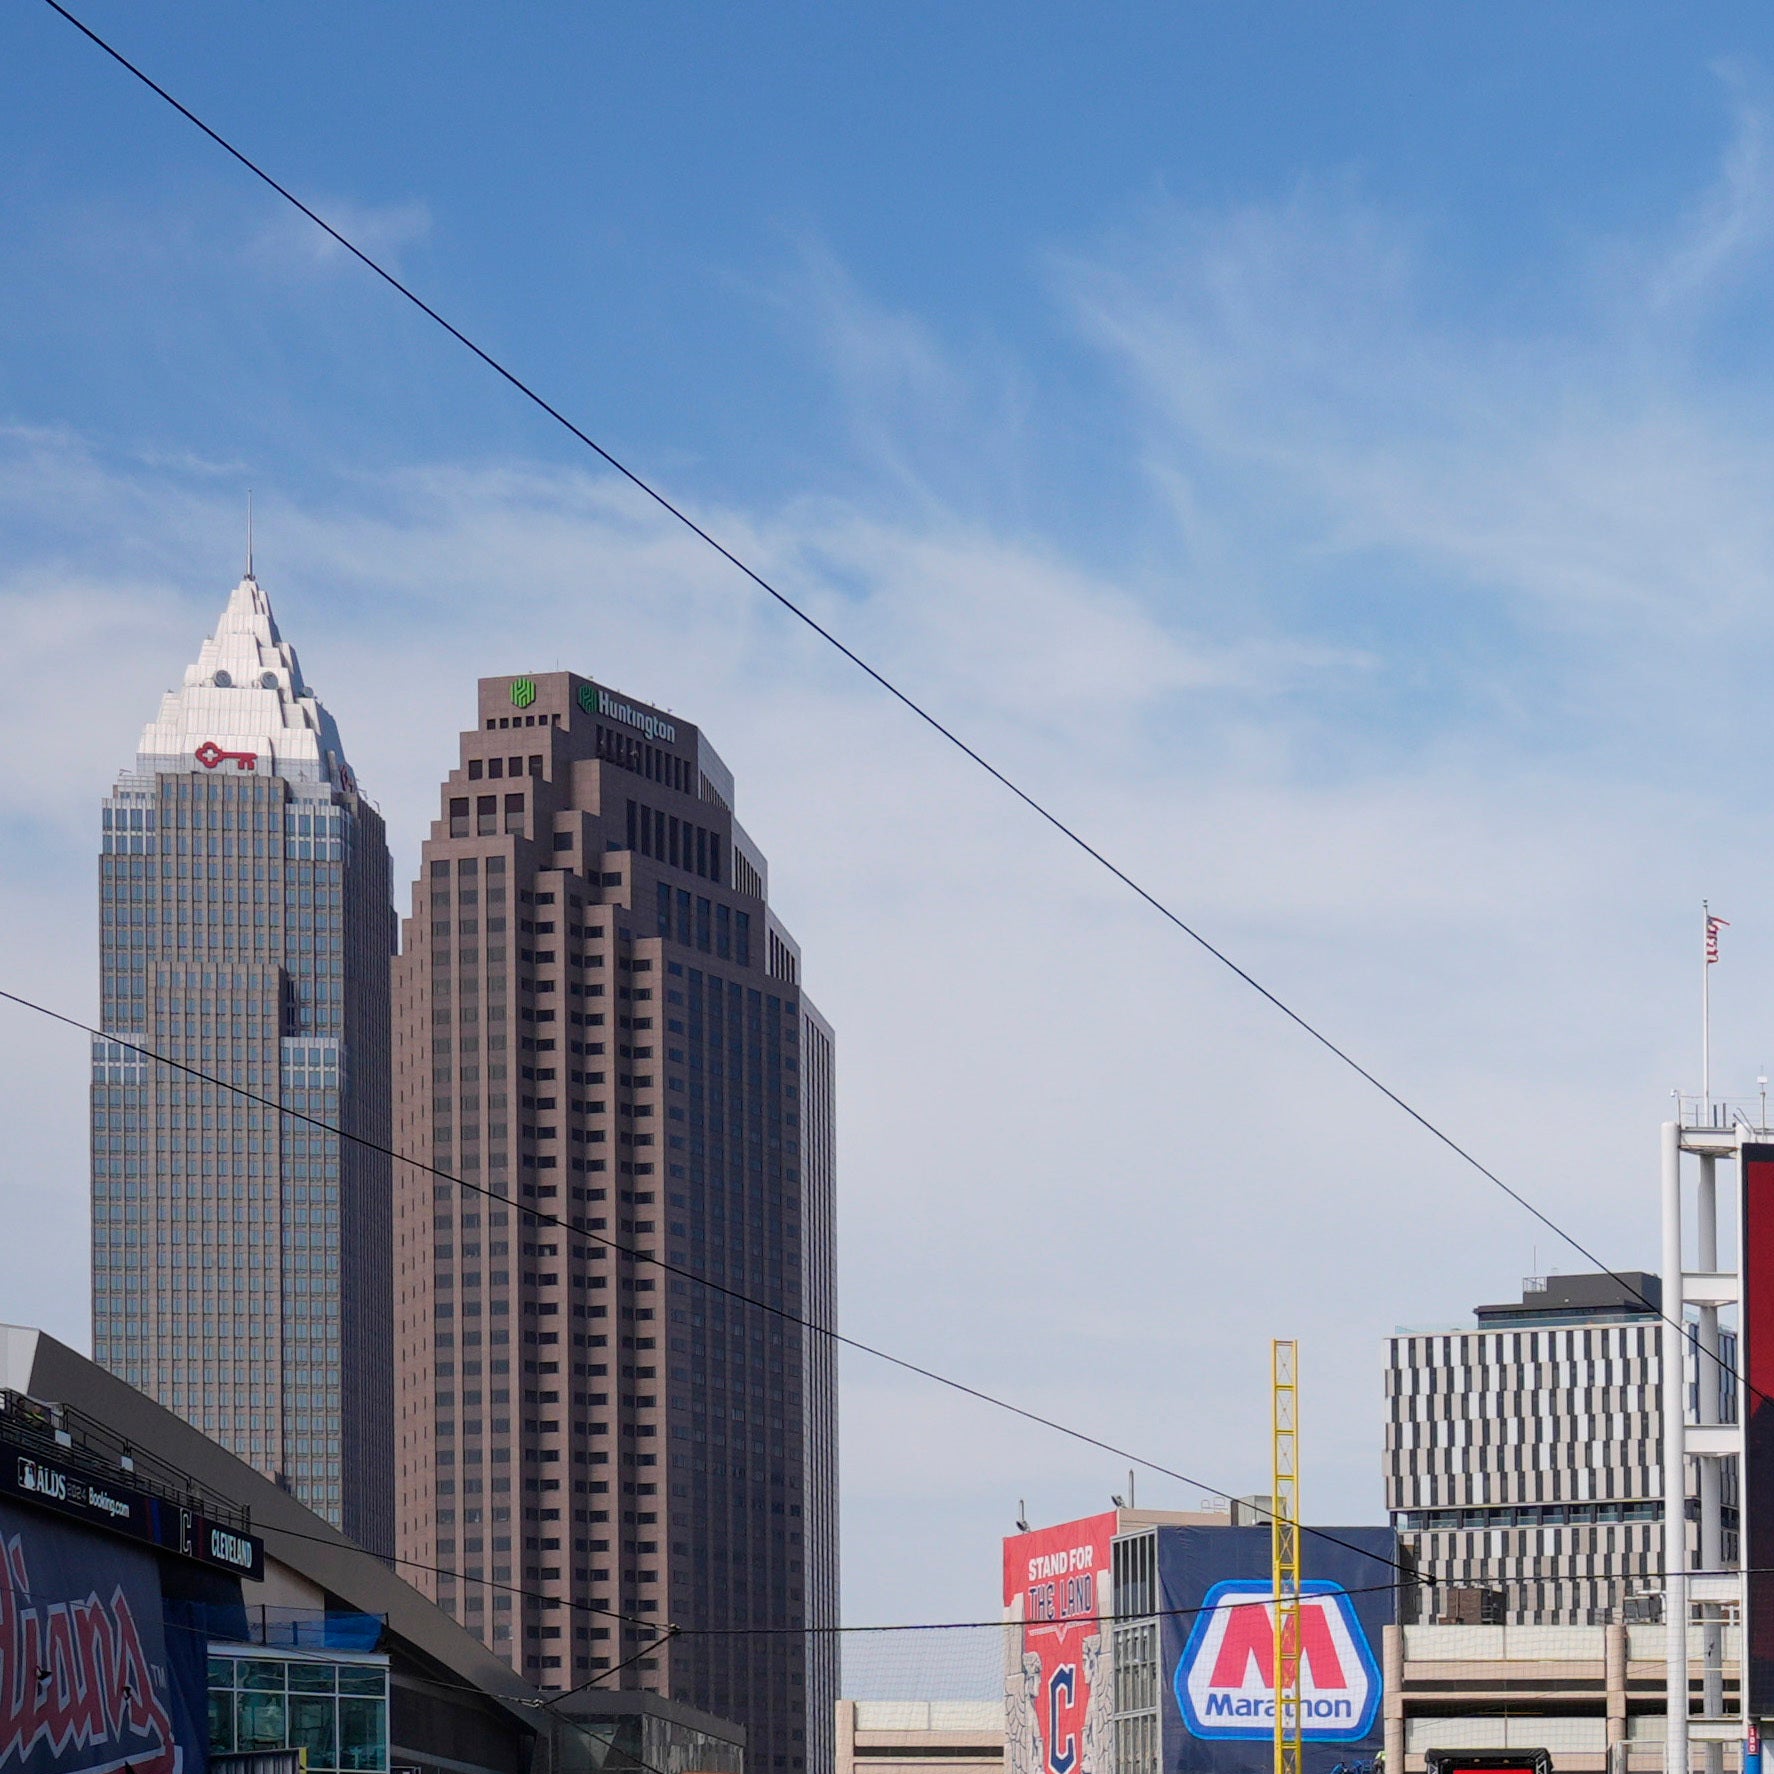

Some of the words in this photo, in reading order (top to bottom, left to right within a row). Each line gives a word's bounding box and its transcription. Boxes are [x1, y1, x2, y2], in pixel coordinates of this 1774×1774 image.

[597, 692, 677, 744] Huntington
[36, 1465, 66, 1501] ALDS
[88, 1486, 130, 1517] Booking.com
[211, 1528, 253, 1569] CLEVELAND
[1028, 1552, 1068, 1582] STAND
[1069, 1544, 1094, 1568] FOR
[1027, 1582, 1056, 1622] THE
[1059, 1572, 1093, 1617] LAND
